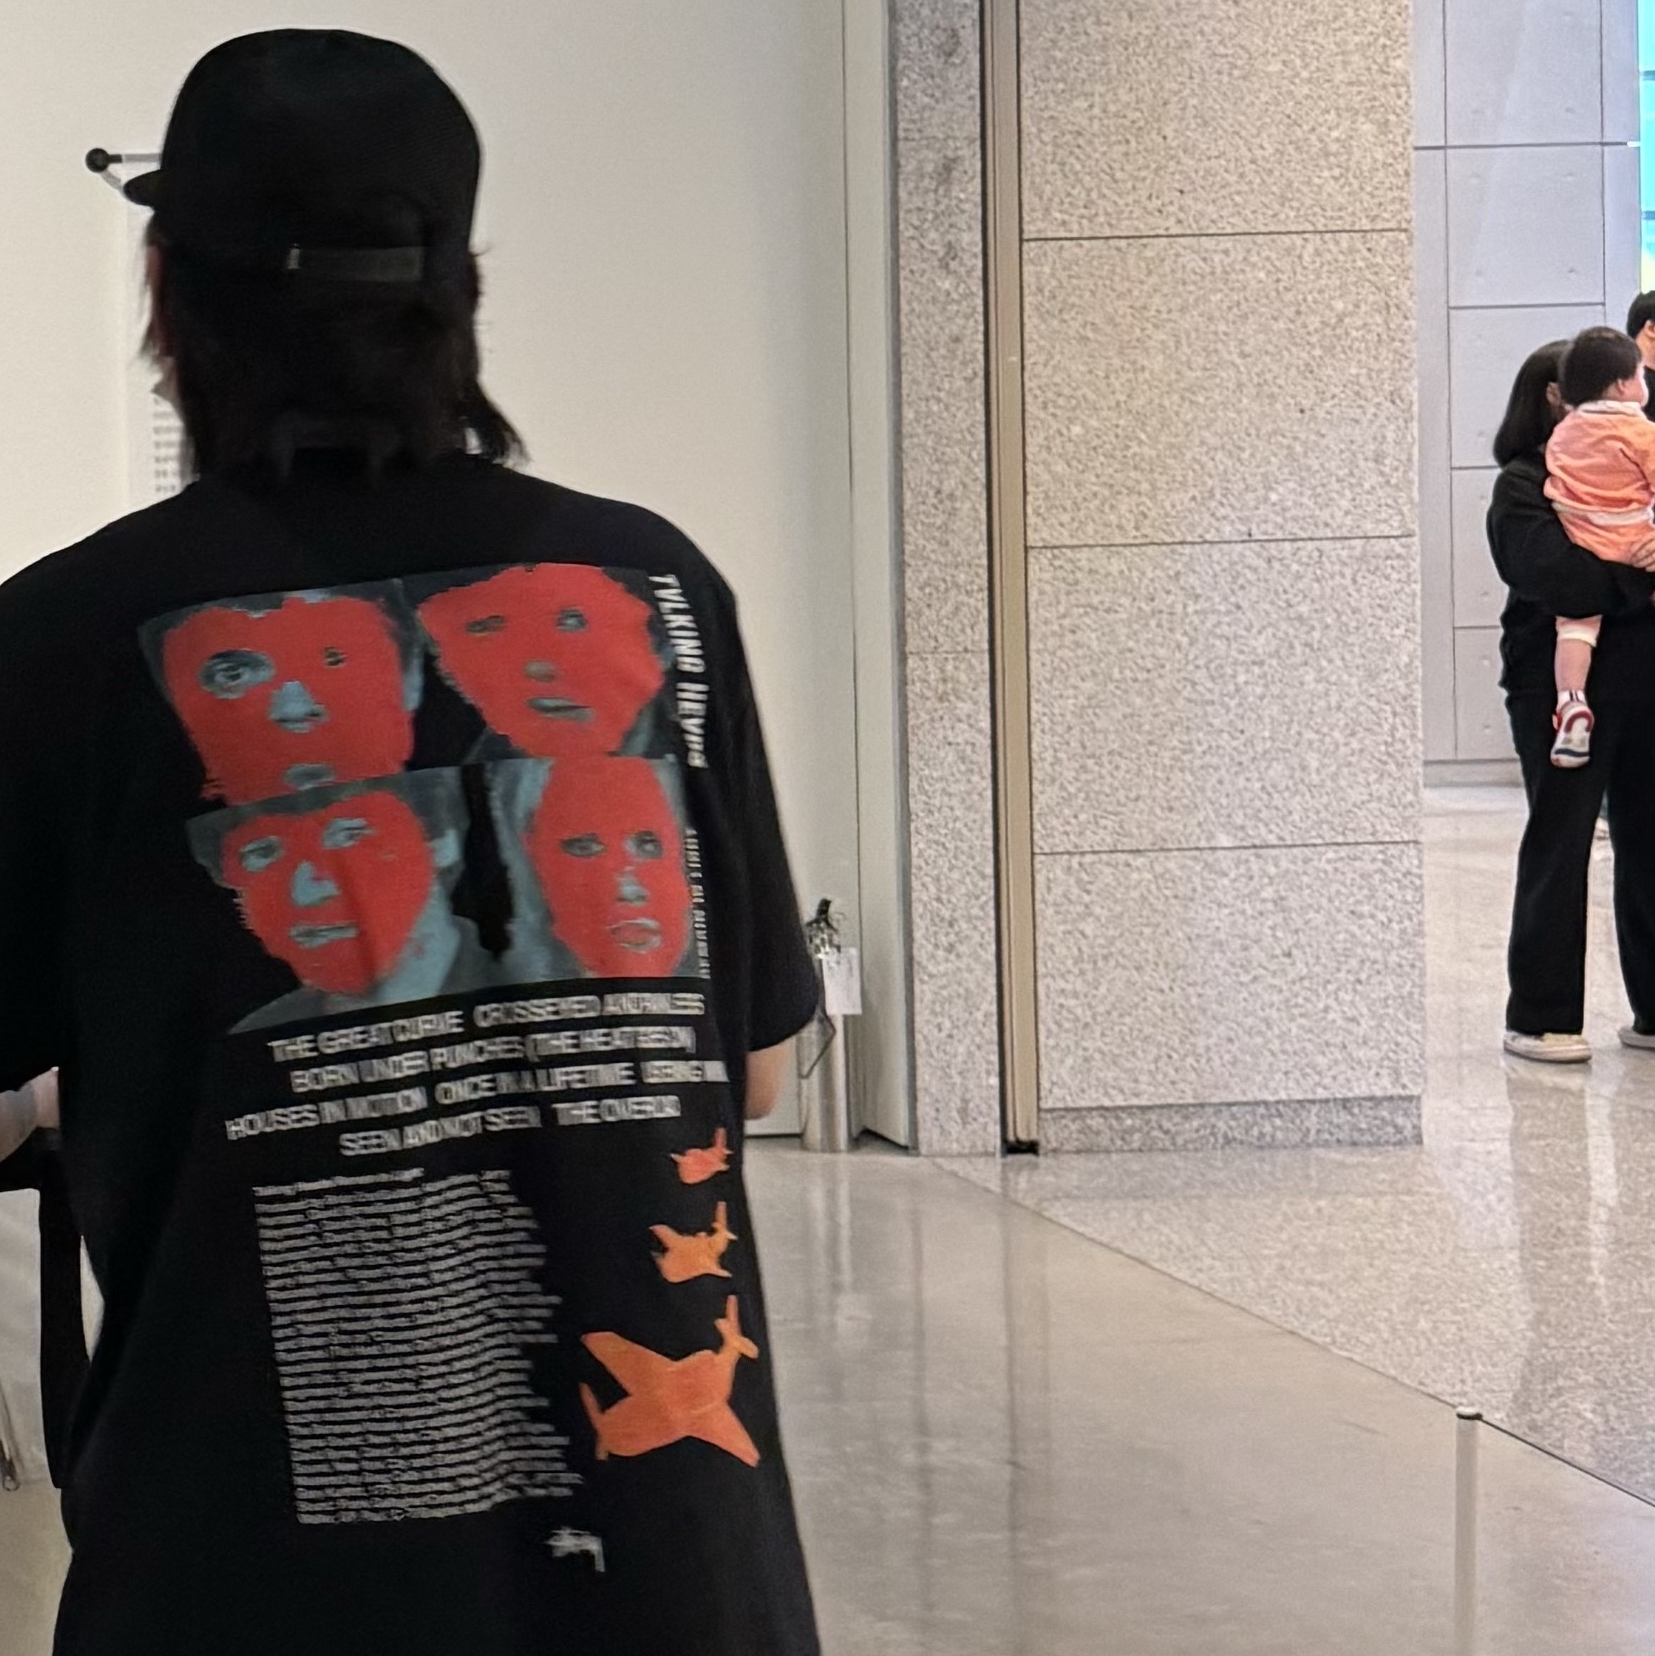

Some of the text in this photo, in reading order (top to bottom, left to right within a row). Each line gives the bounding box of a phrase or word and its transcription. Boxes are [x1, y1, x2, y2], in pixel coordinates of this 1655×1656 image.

[267, 1034, 319, 1062] THE
[317, 1021, 394, 1054] GREAT
[290, 1062, 360, 1093] BORN
[359, 1050, 430, 1083] UNDER
[429, 1035, 525, 1071] PUNCHES
[225, 1104, 320, 1140] HOUSES
[434, 1074, 497, 1105] ONCE
[339, 1128, 402, 1156] SEEN
[482, 1105, 543, 1132] SEEN
[551, 1100, 601, 1126] THE
